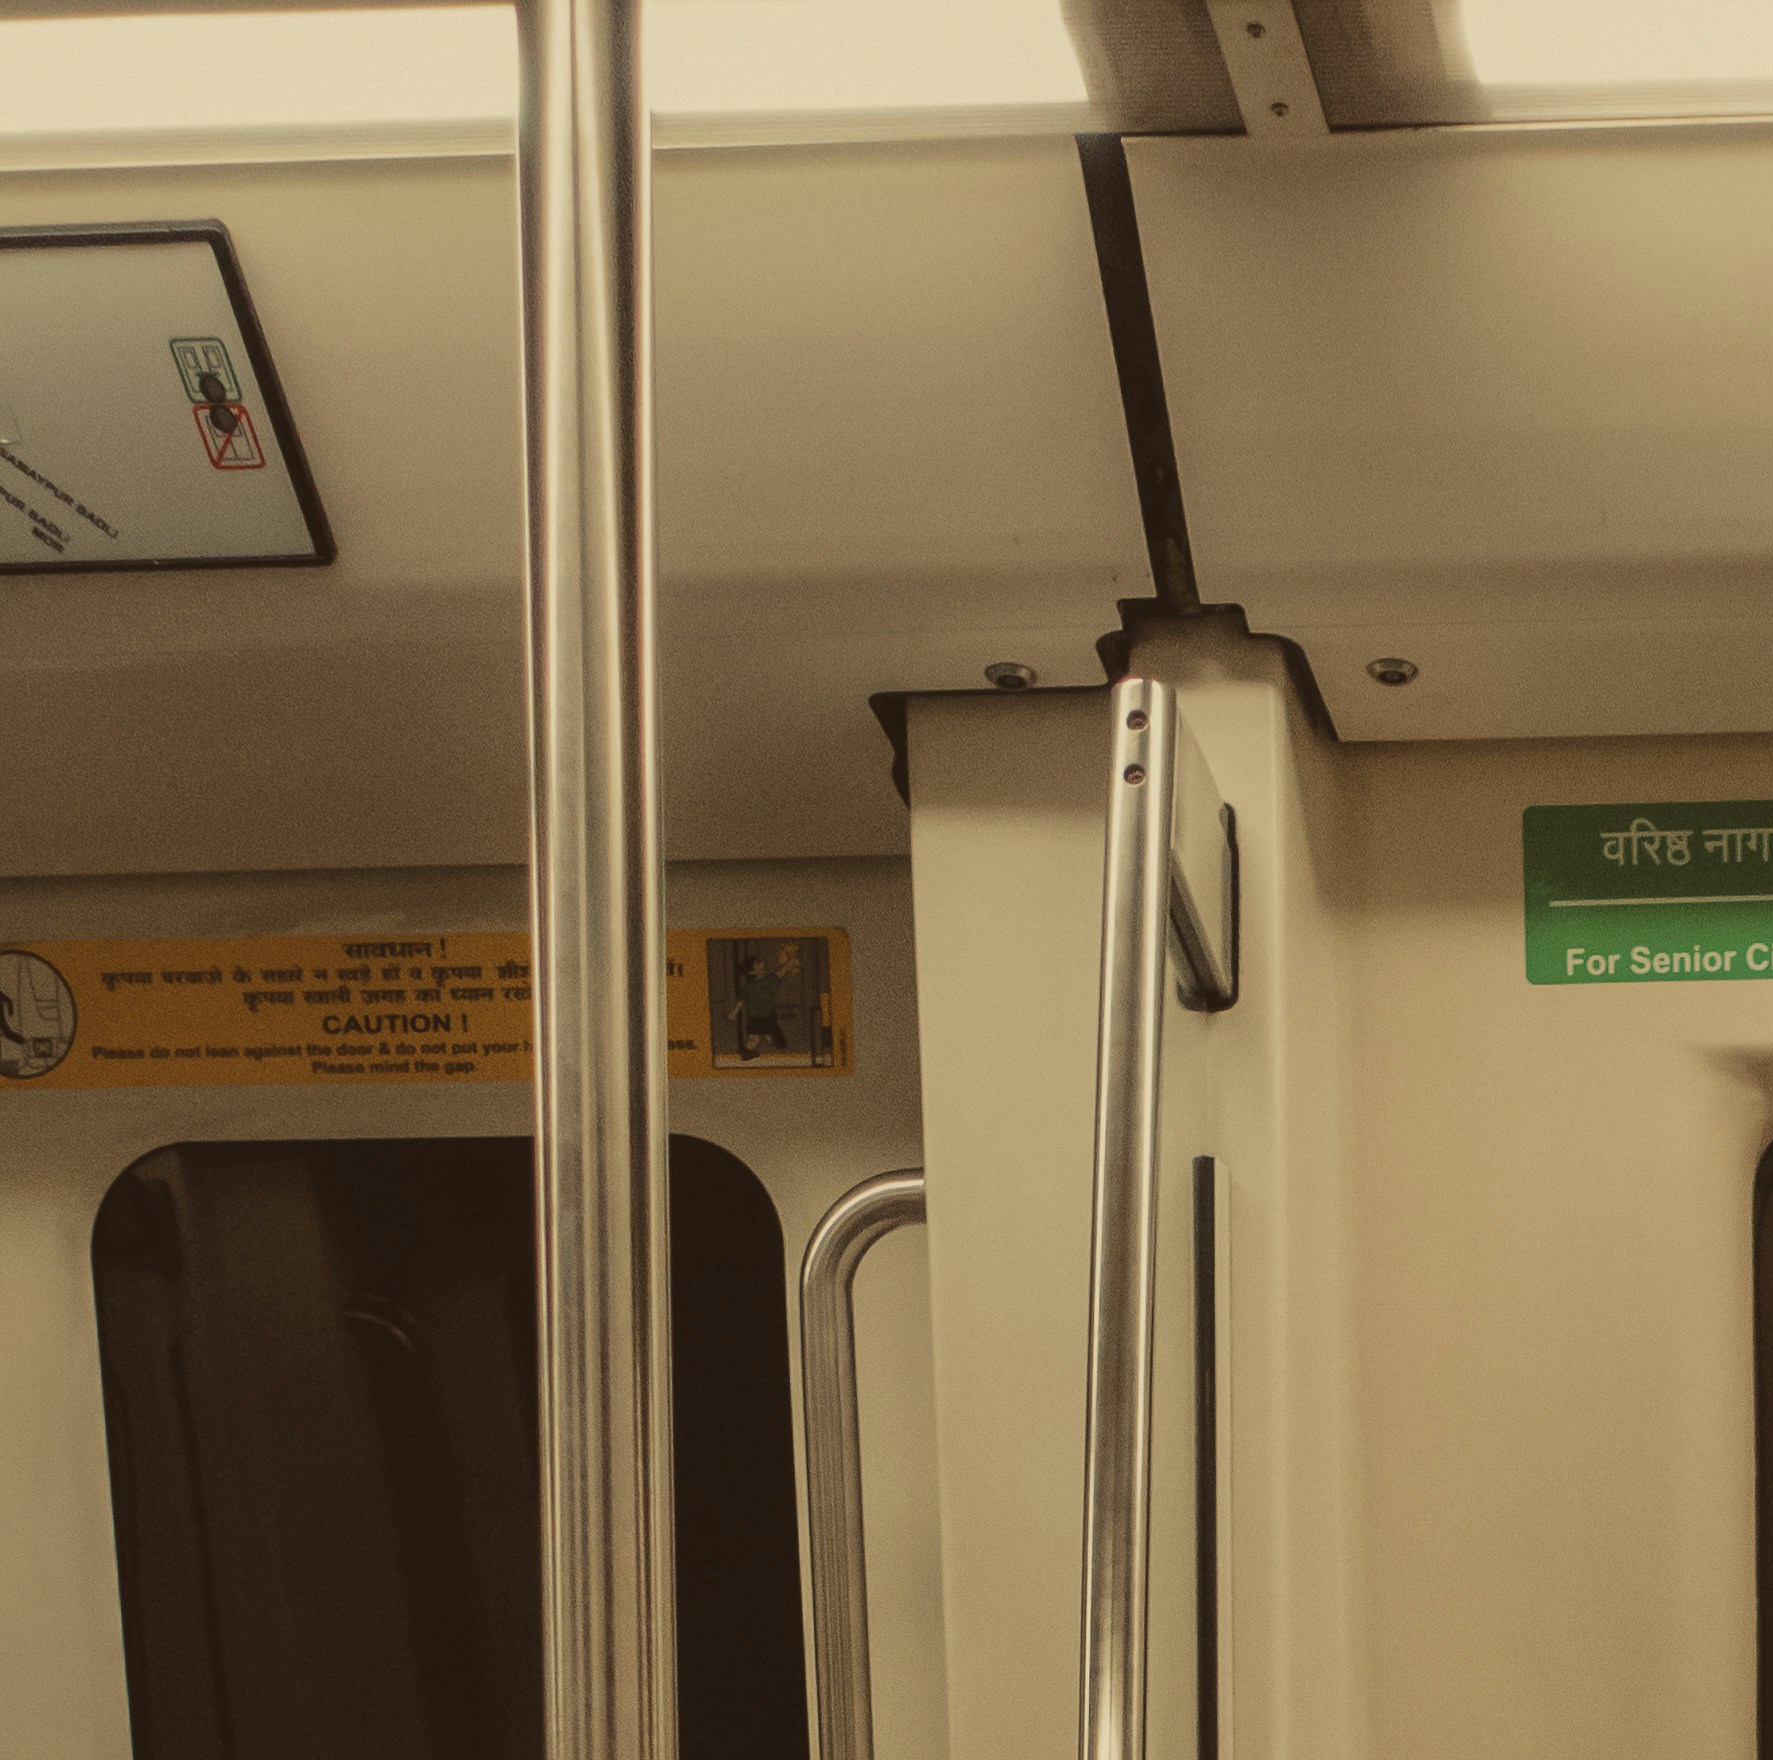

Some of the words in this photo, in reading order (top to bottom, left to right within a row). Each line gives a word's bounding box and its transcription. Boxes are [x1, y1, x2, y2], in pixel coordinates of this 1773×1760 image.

[1600, 817, 1693, 866] वरिष्ठ
[341, 942, 432, 958] सावधान
[1566, 947, 1621, 976] For
[1630, 944, 1737, 975] Senior
[322, 1013, 450, 1034] CAUTION
[151, 1046, 170, 1059] do
[175, 1046, 200, 1058] not
[307, 1043, 331, 1057] the
[336, 1043, 372, 1056] door
[396, 1042, 416, 1055] do
[421, 1042, 446, 1055] not
[451, 1042, 477, 1056] put
[482, 1043, 518, 1057] your
[312, 1061, 365, 1074] Please
[369, 1060, 409, 1073] mind
[415, 1060, 438, 1073] the
